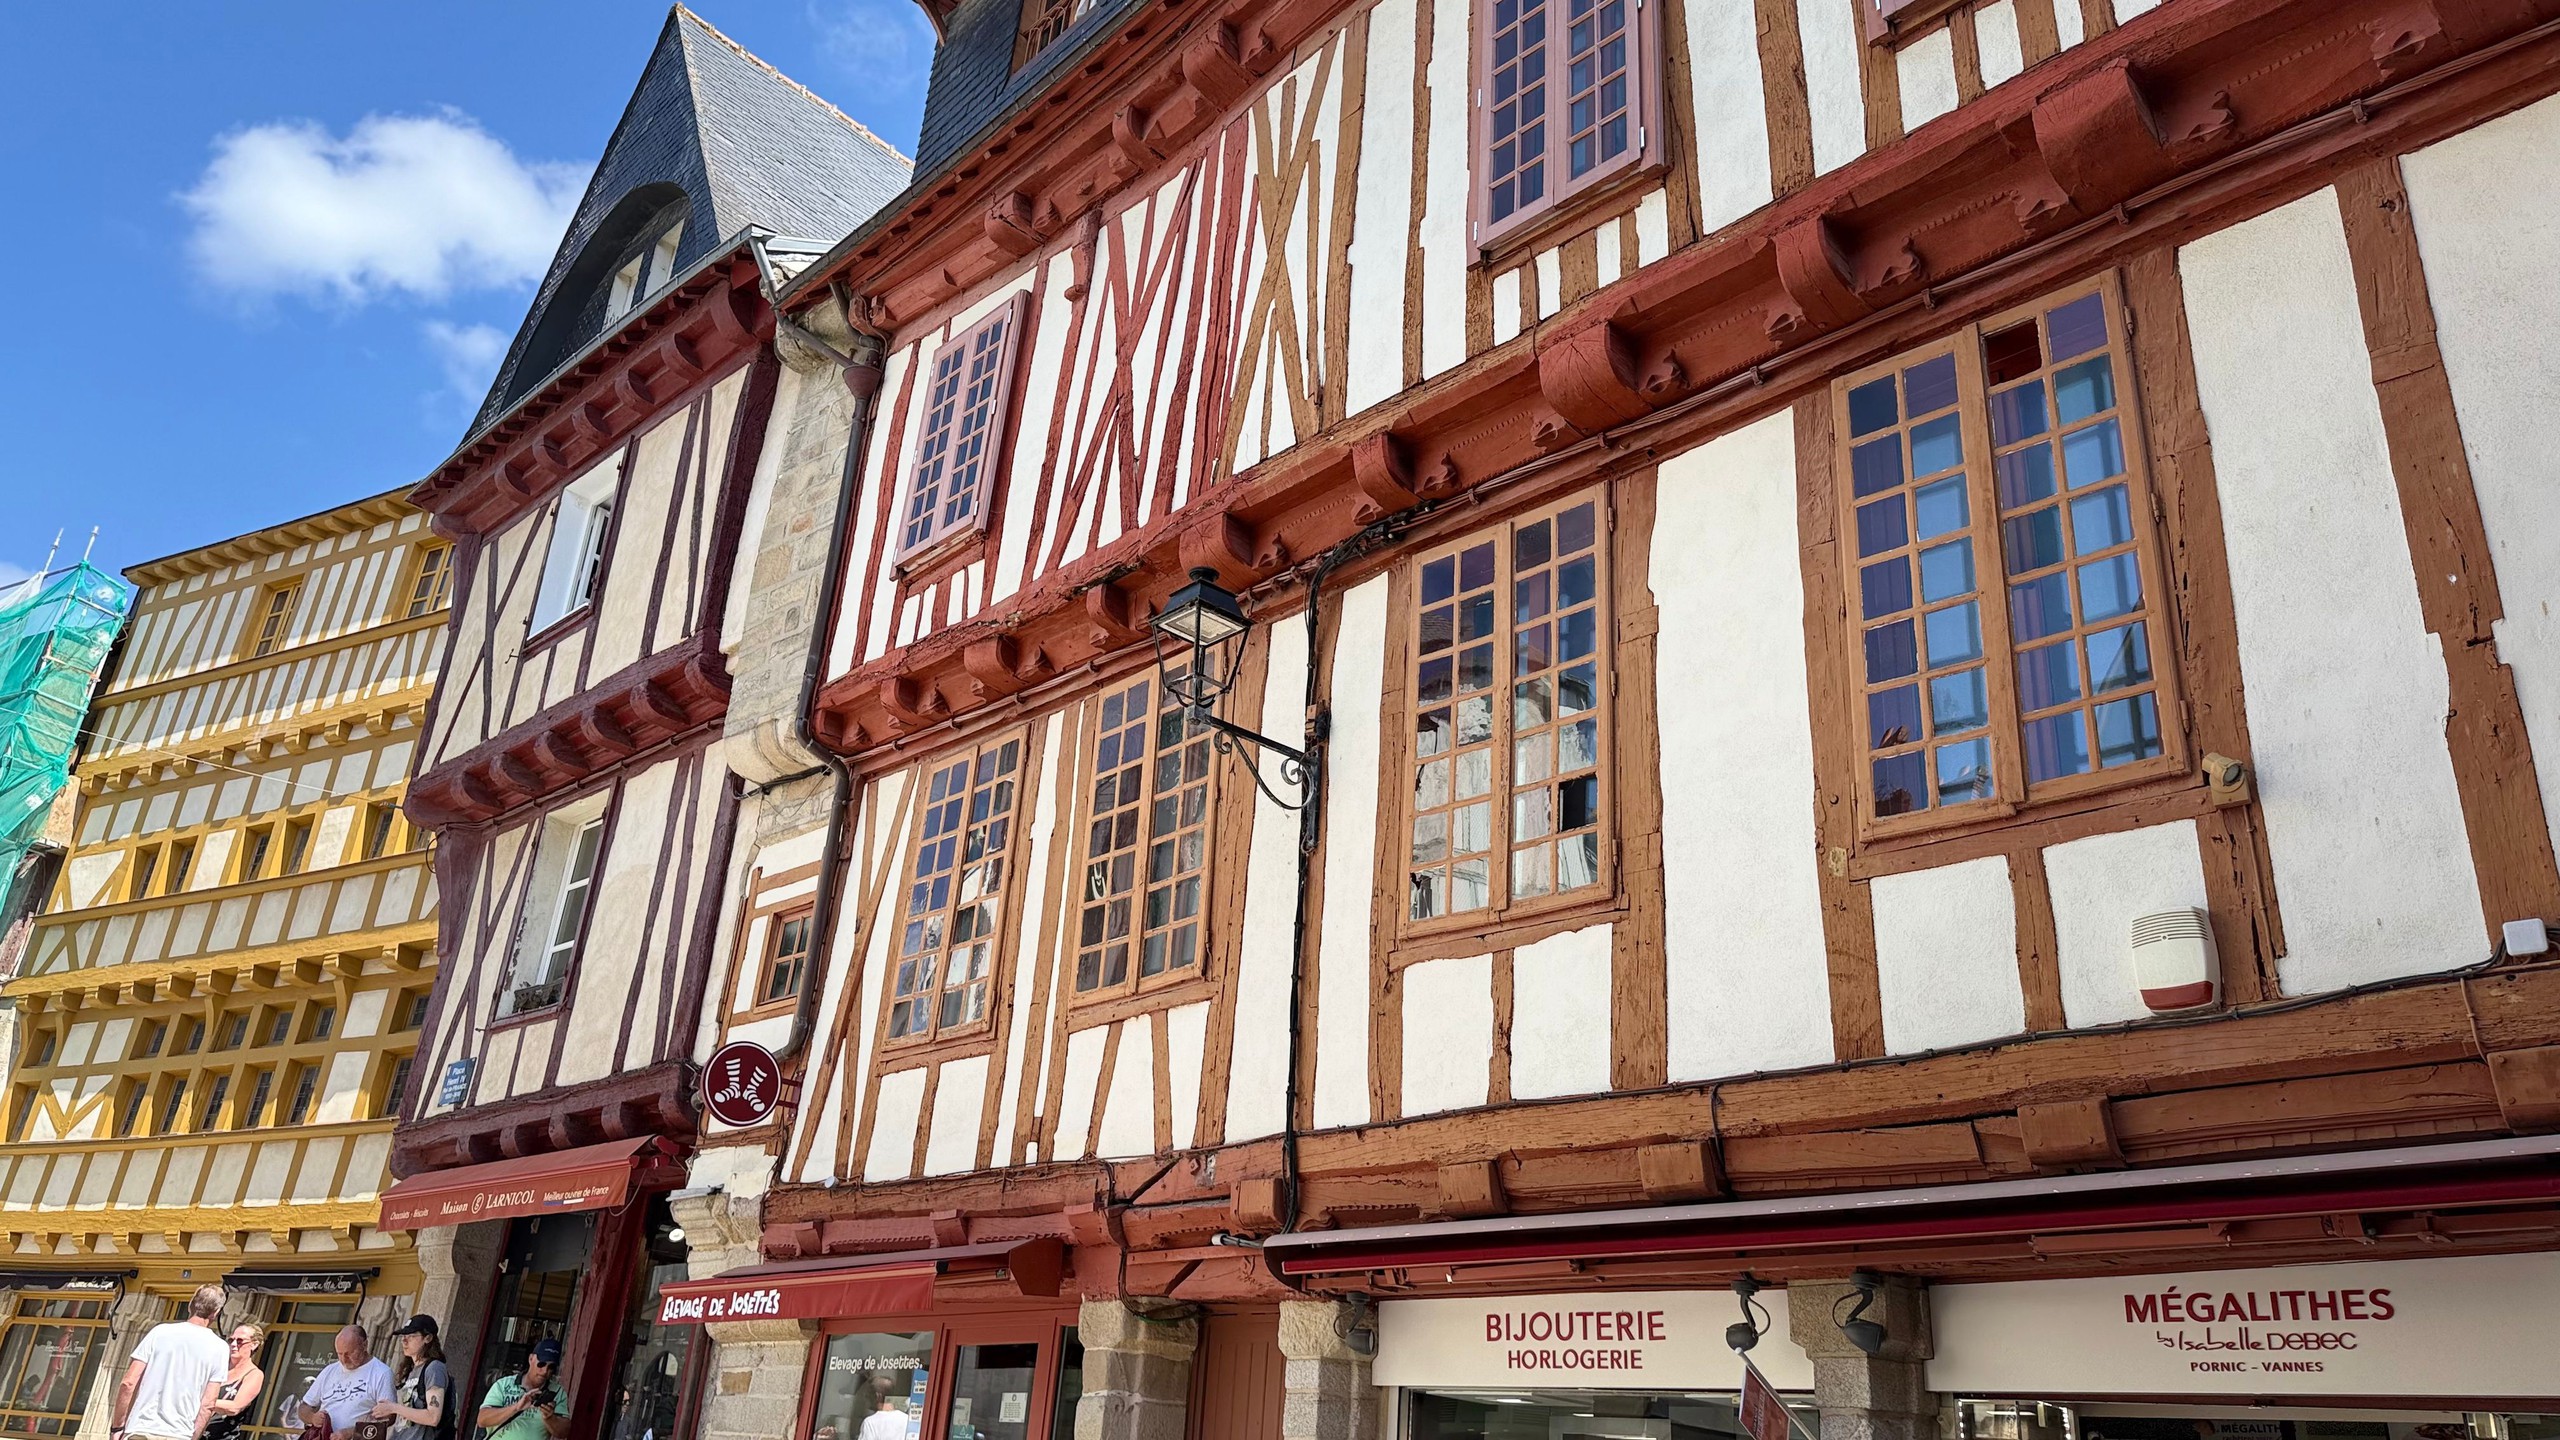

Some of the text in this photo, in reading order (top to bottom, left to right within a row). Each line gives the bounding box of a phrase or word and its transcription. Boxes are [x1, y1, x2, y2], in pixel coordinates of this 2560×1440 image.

[440, 1201, 468, 1216] Maison
[485, 1190, 536, 1210] LARNICOL
[544, 1185, 609, 1201] Meilleur ouvrier de France
[661, 1289, 781, 1322] ELEVAGE DE JOSETTES
[2124, 1286, 2395, 1323] MÉGALITHES
[1486, 1310, 1666, 1342] BIJOUTERIE
[2156, 1330, 2175, 1347] by
[2178, 1327, 2266, 1351] Isabelle
[829, 1355, 923, 1374] Elevage de Josettes.
[1508, 1348, 1643, 1370] HORLOGERIE
[2190, 1361, 2247, 1372] PORNIC
[2261, 1361, 2324, 1372] VANNES
[2221, 1423, 2281, 1434] MÉGALITH
